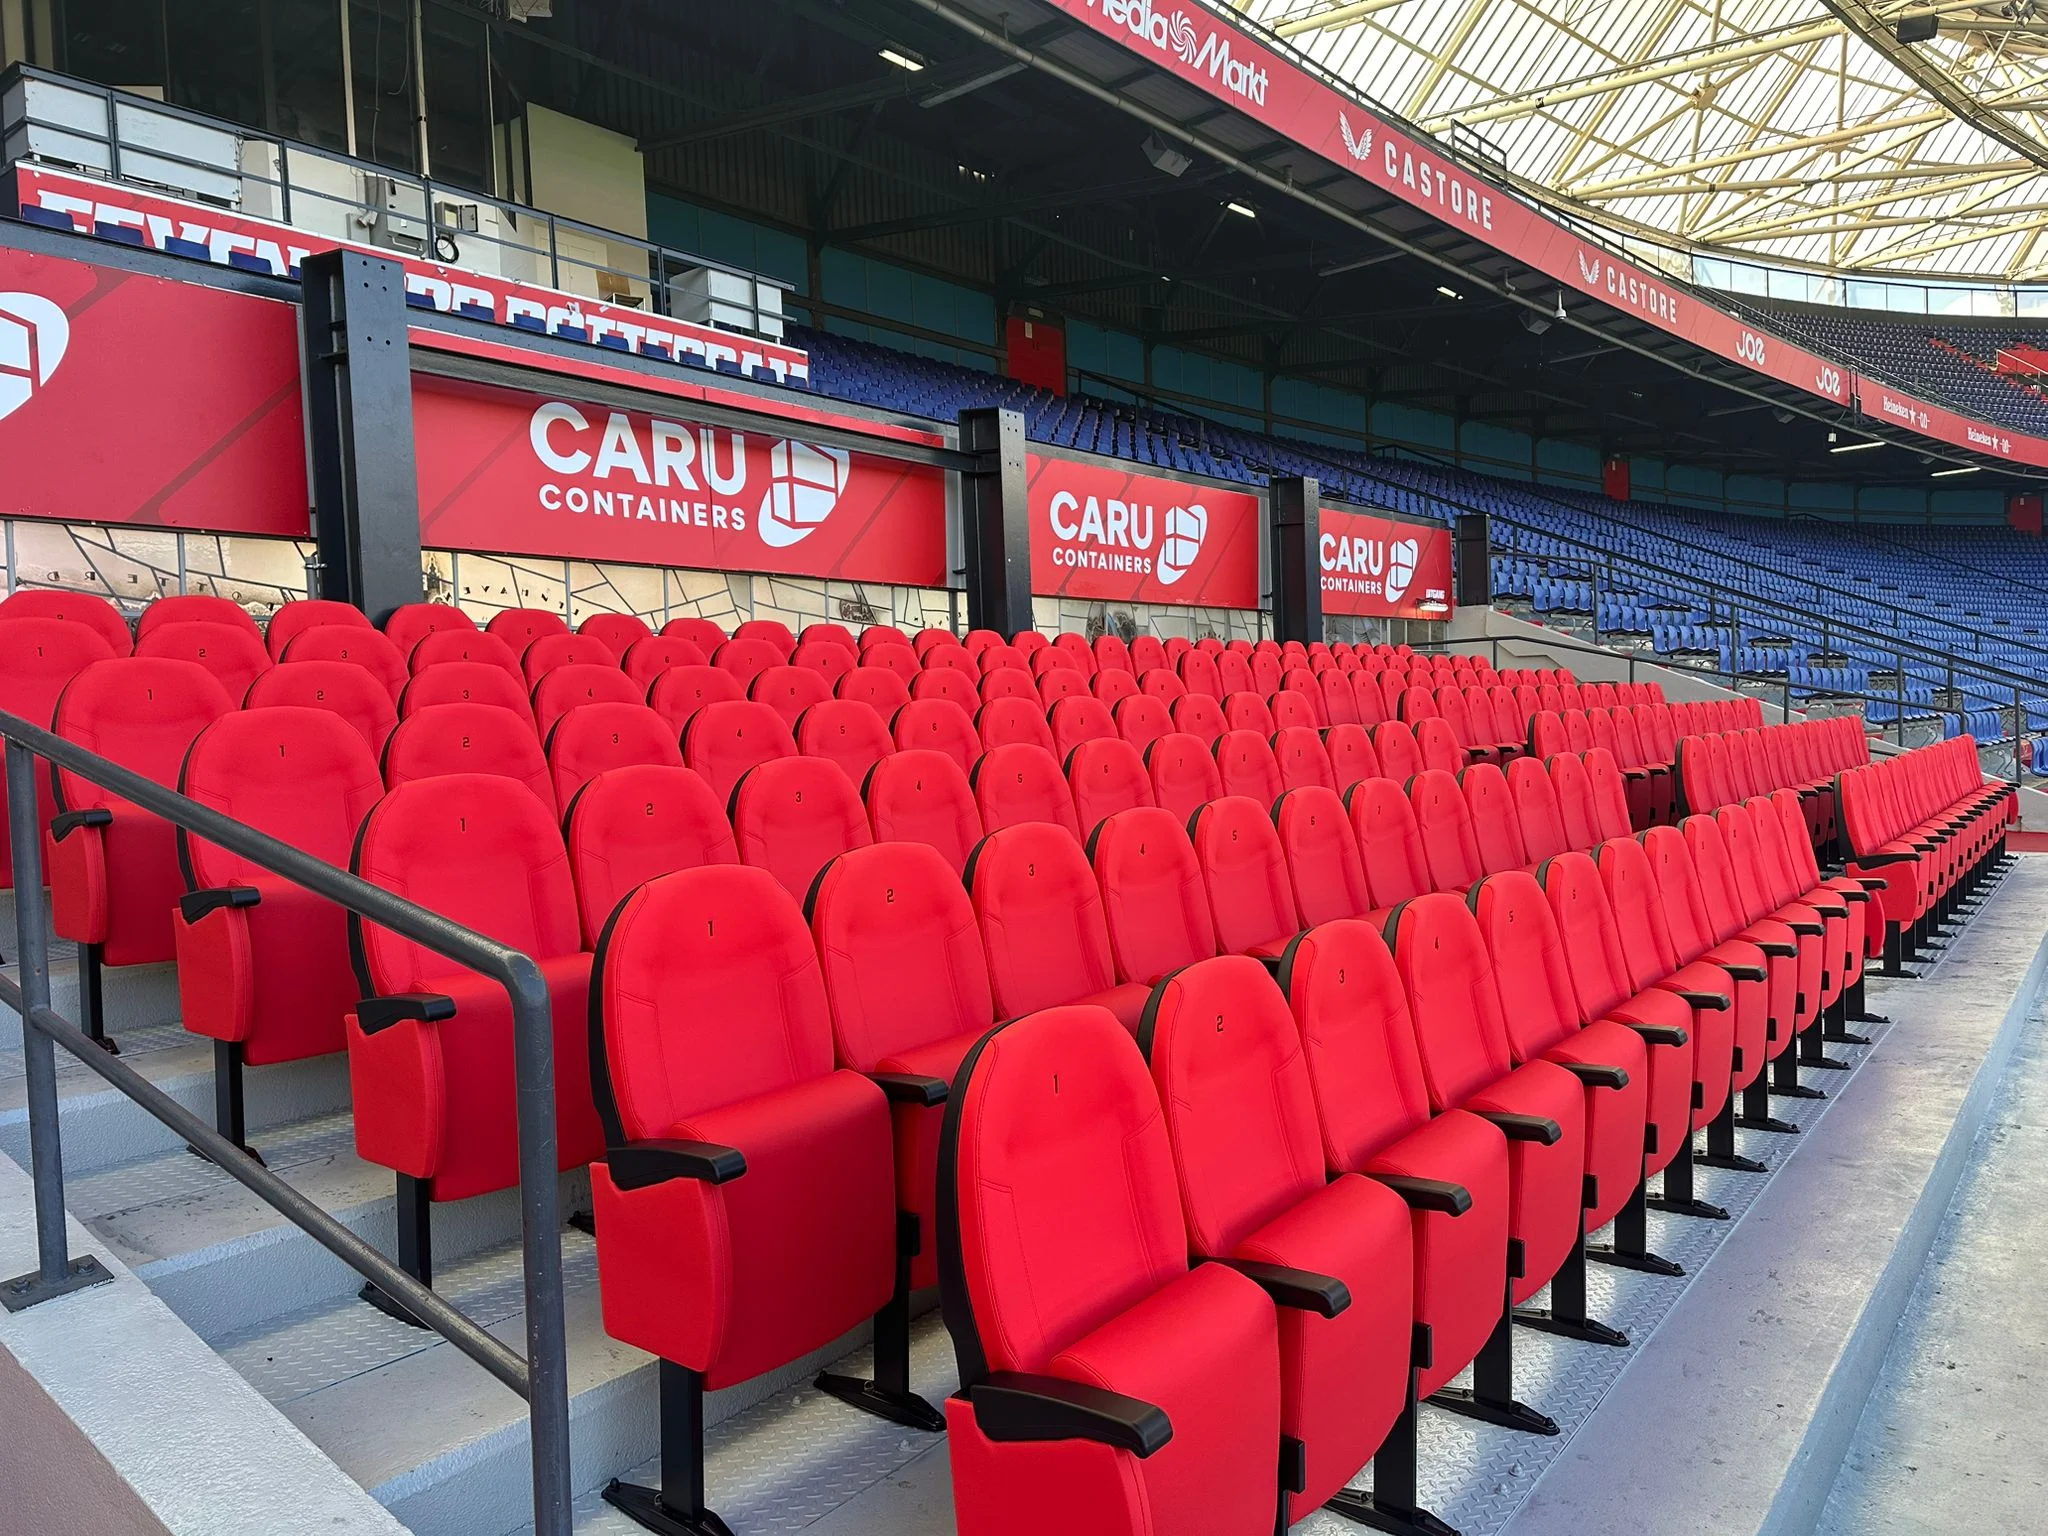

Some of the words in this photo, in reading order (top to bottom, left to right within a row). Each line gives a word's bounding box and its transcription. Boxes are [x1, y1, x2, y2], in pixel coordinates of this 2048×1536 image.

[1086, 0, 1169, 50] edia
[1192, 31, 1269, 107] Markt
[1384, 140, 1493, 231] CASTORE
[1606, 265, 1678, 324] CASTORE
[530, 403, 747, 496] CARU
[539, 483, 747, 531] CONTAINERS
[1049, 490, 1154, 550] CARU
[1052, 547, 1153, 574] CONTAINERS
[1319, 532, 1383, 576] CARU
[1320, 575, 1382, 595] CONTAINERS
[341, 649, 348, 660] 3
[316, 689, 325, 701] 2
[462, 689, 470, 700] 3
[462, 736, 471, 748] 2
[612, 733, 619, 744] 3
[279, 744, 285, 758] 1
[795, 791, 802, 803] 3
[645, 802, 654, 816] 2
[460, 817, 466, 832] 1
[1028, 863, 1035, 877] 3
[886, 888, 895, 904] 2
[707, 920, 714, 937] 1
[1338, 968, 1345, 984] 3
[1216, 1014, 1224, 1033] 2
[1053, 1073, 1059, 1094] 1
